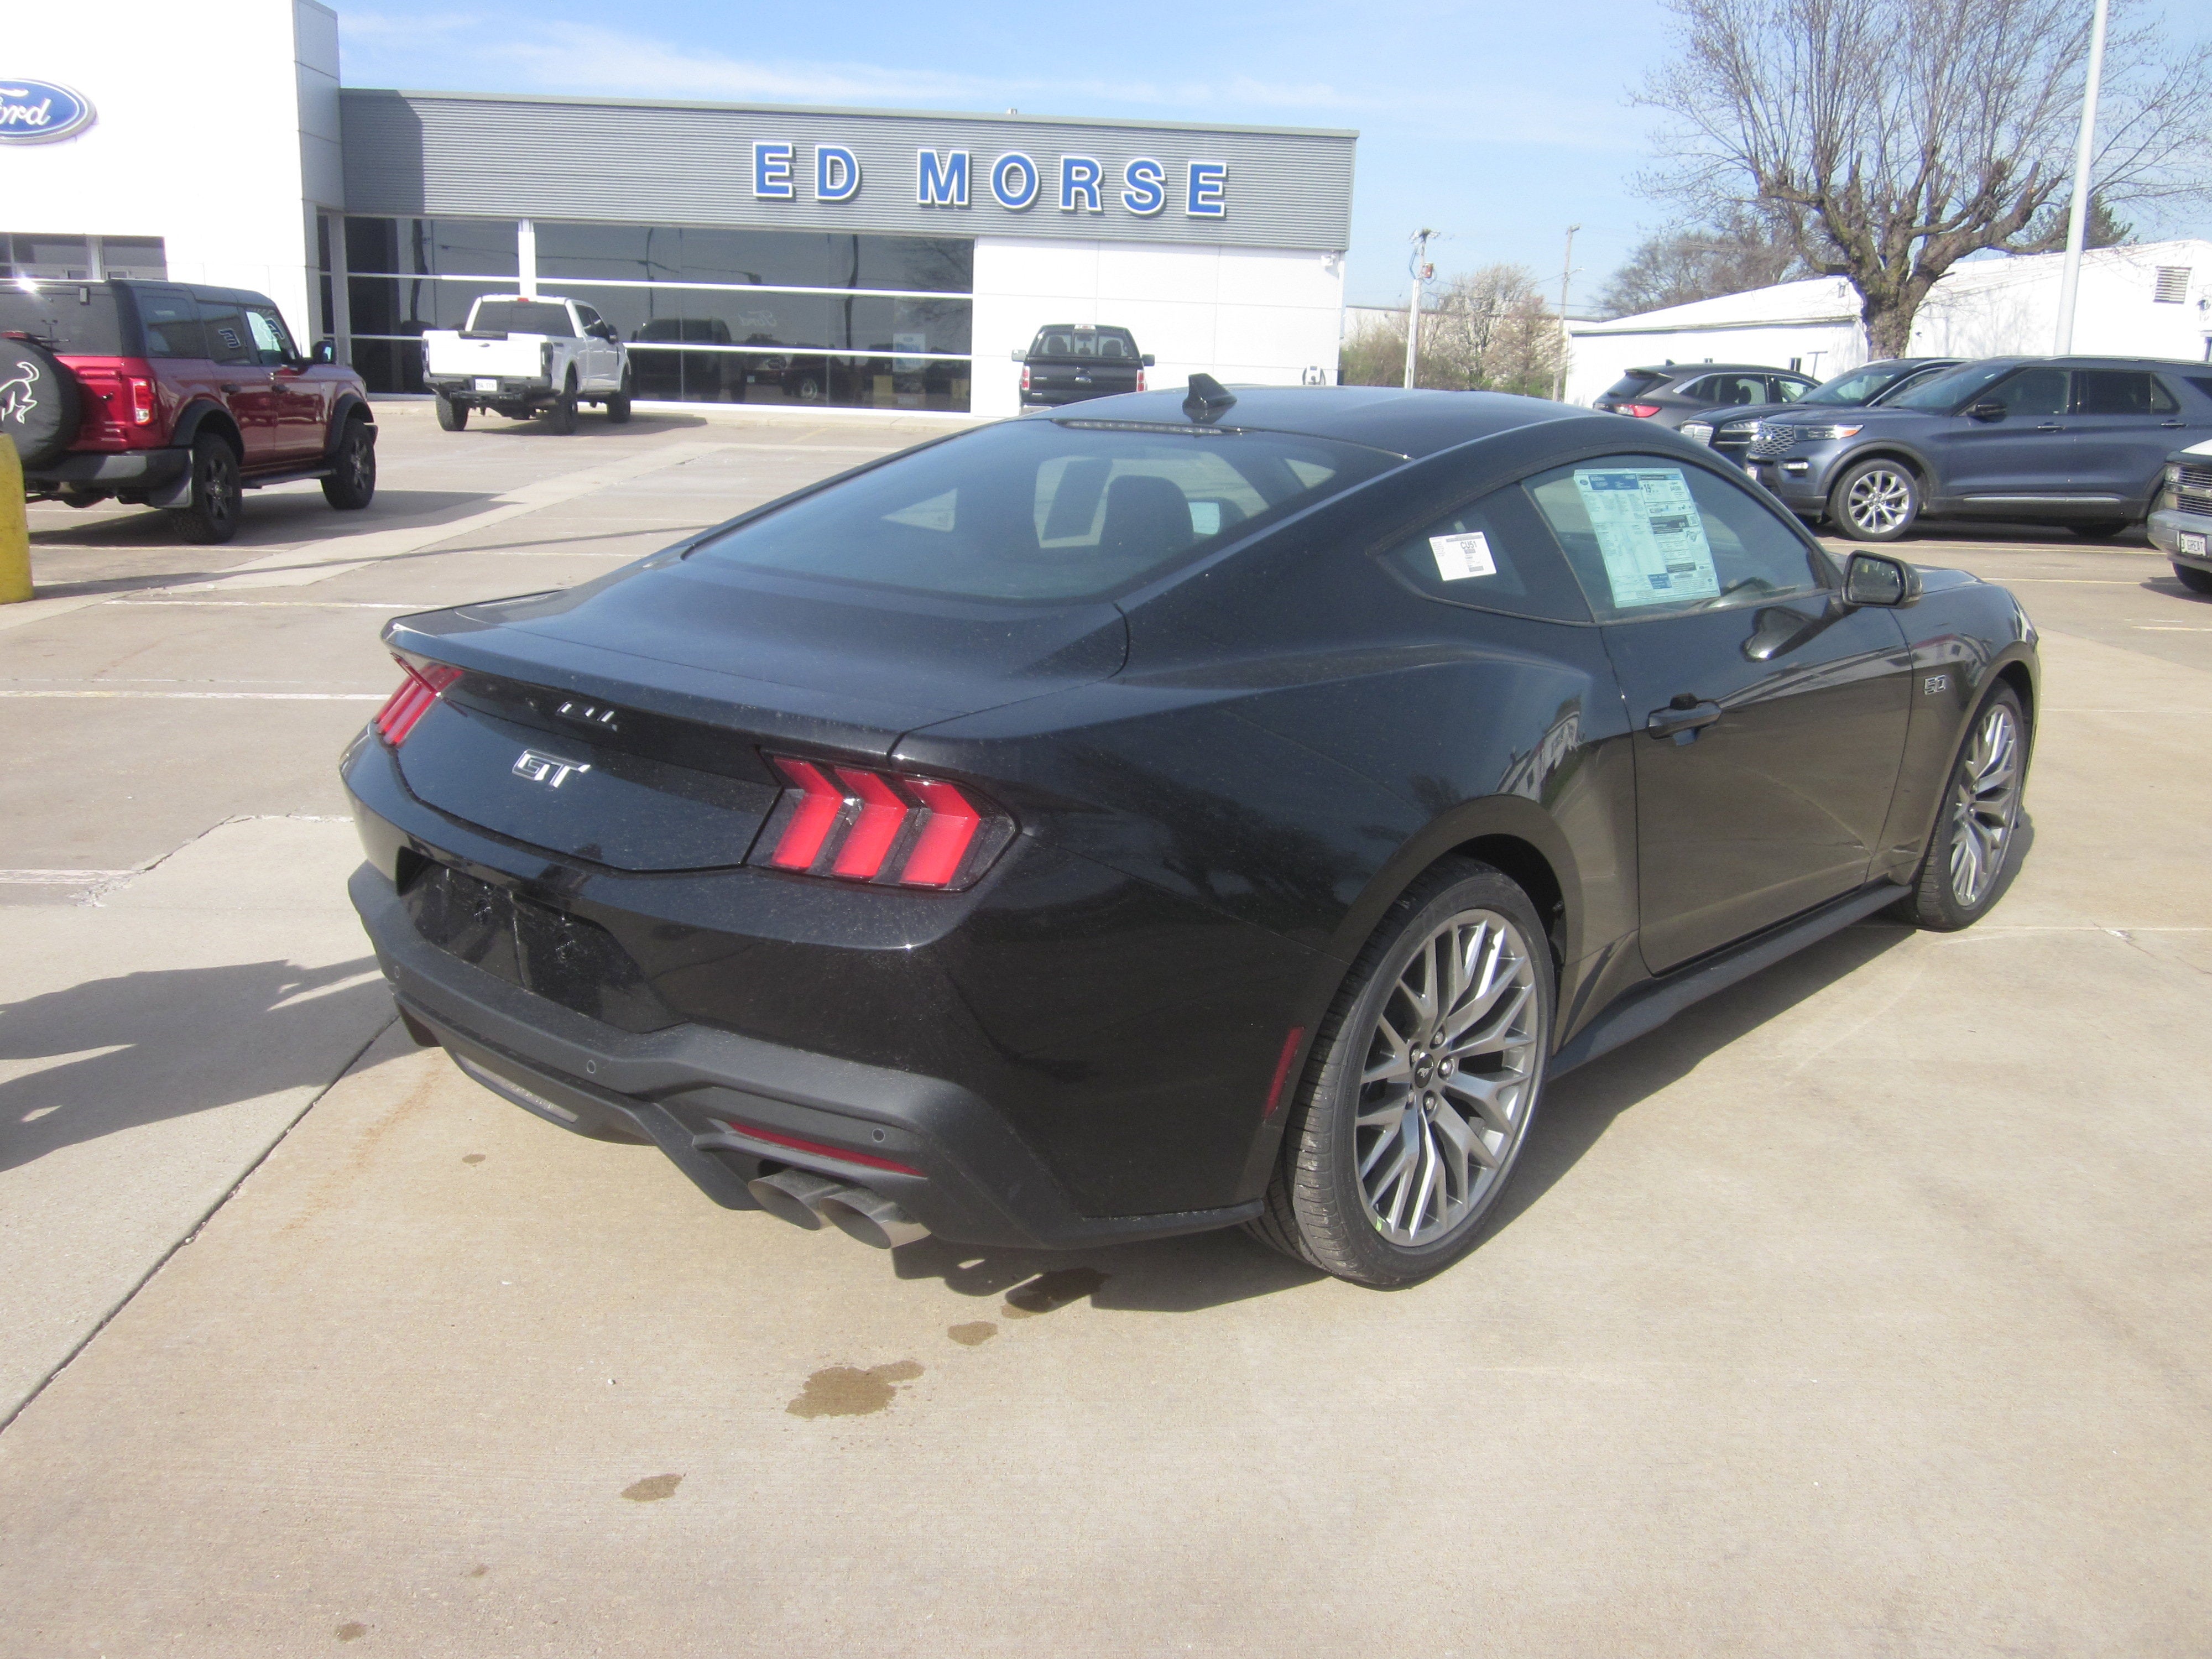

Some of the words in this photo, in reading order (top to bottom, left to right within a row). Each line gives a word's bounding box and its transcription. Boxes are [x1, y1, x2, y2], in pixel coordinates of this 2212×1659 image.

[753, 141, 860, 200] ED
[916, 149, 1227, 216] MORSE
[1460, 540, 1478, 550] CU51
[512, 749, 591, 789] GT
